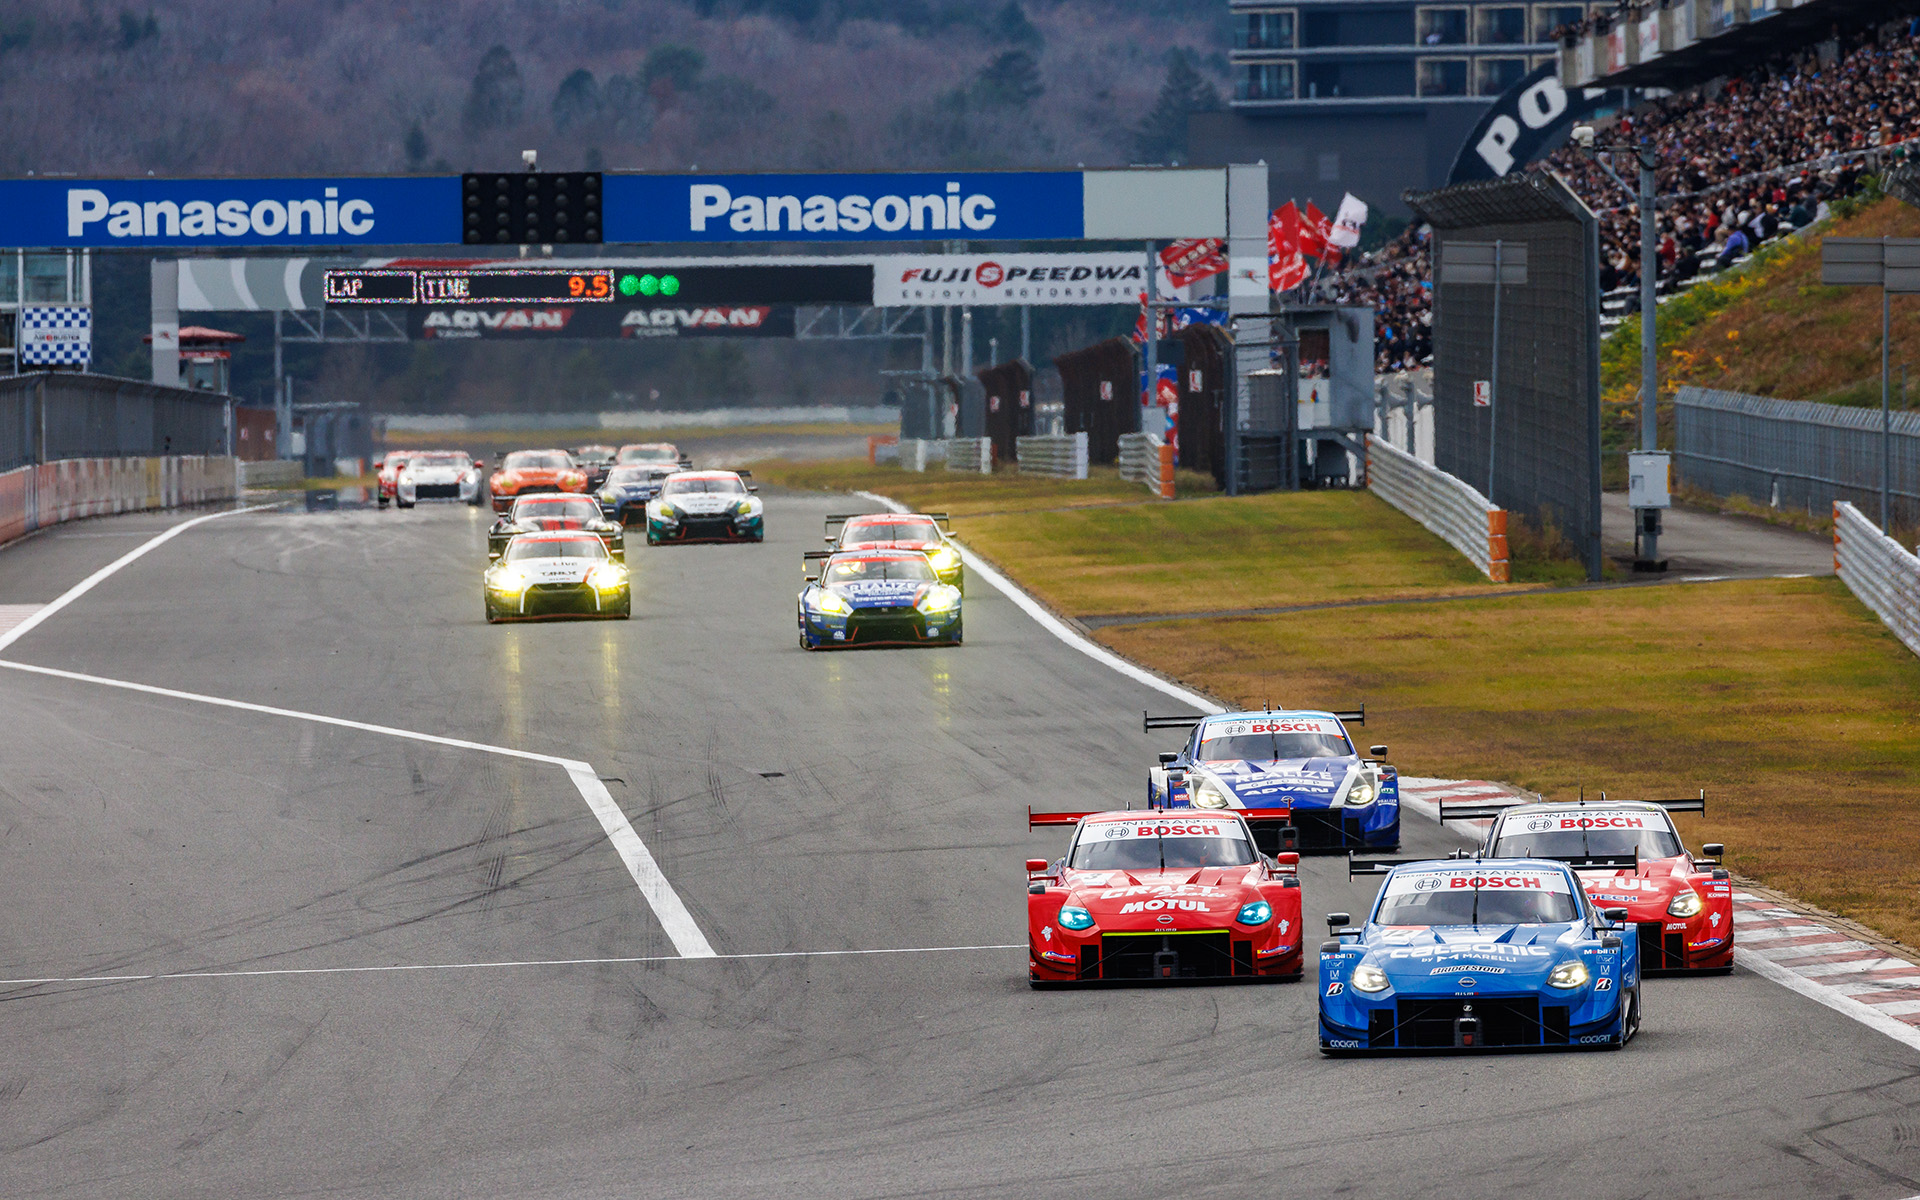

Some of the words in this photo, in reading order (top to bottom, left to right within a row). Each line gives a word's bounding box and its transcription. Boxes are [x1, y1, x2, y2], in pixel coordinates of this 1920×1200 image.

[67, 188, 374, 237] Panasonic
[690, 182, 997, 232] Panasonic
[901, 267, 972, 283] FUJI
[329, 278, 363, 297] LAP
[424, 278, 470, 297] TIME
[568, 275, 608, 297] 9.5
[423, 310, 565, 328] ADVAN
[621, 308, 761, 327] ADVAN
[1252, 723, 1321, 733] BOSCH
[1236, 771, 1333, 783] REALIZE
[1243, 786, 1329, 796] ADVAN
[1560, 817, 1644, 829] BOSCH
[1137, 825, 1220, 837] BOSCH
[1450, 877, 1541, 889] BOSCH
[1581, 877, 1659, 892] OTUL
[1100, 884, 1219, 900] CRAFT
[1588, 893, 1639, 903] TECH
[1119, 898, 1211, 915] MOTUL
[1665, 922, 1688, 931] MOTUL
[1321, 953, 1346, 961] Mobil
[1462, 953, 1517, 963] MARELLI
[1429, 964, 1506, 976] BRIDGESTONE
[1330, 1040, 1359, 1048] COCKPIT
[1580, 1034, 1611, 1044] COCKPIT
